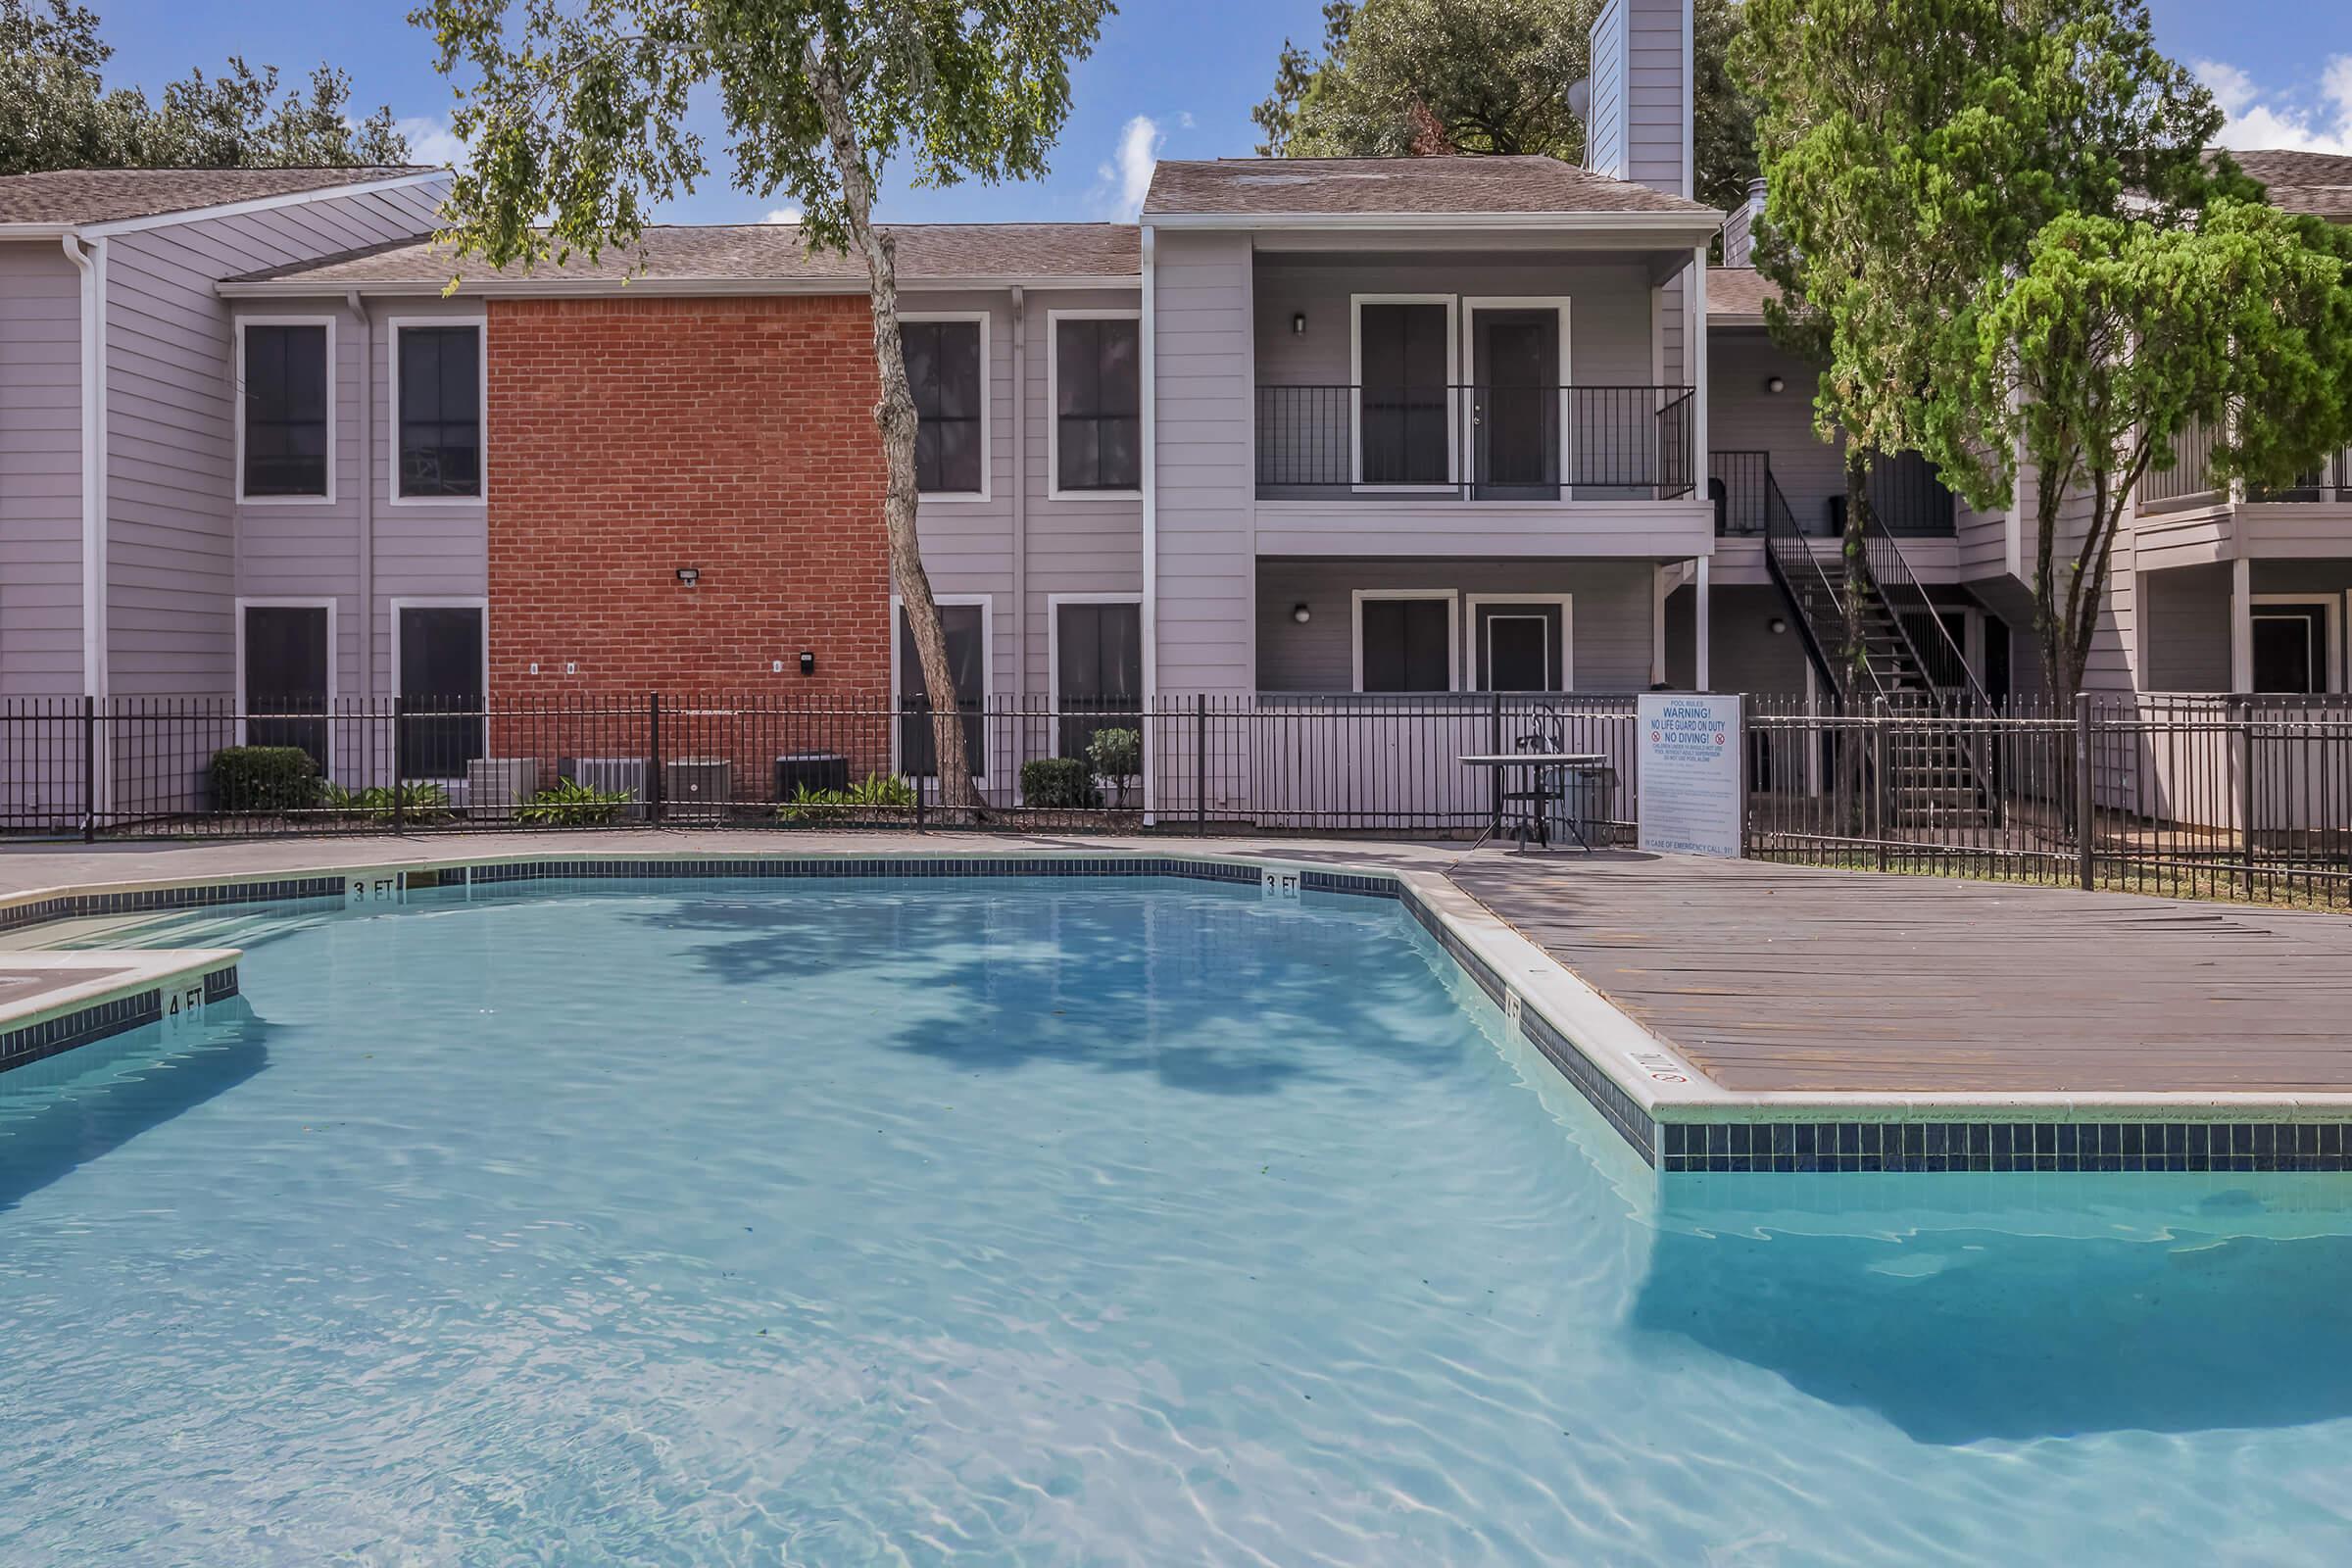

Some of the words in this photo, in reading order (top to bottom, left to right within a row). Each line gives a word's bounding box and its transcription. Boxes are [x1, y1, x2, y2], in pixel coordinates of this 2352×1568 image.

[1663, 708, 1711, 718] WARNING!
[1651, 719, 1660, 730] NO
[1662, 719, 1674, 730] LIFE
[1675, 719, 1696, 731] GUARD
[1697, 721, 1707, 731] ON
[1708, 720, 1726, 732] DUTY
[1665, 732, 1677, 743] NO
[1679, 732, 1709, 745] DIVING!
[1651, 839, 1665, 848] CASE
[354, 881, 365, 894] 3
[374, 879, 394, 894] FT
[1266, 875, 1275, 887] 3
[1283, 876, 1298, 890] FT
[170, 995, 179, 1015] 4
[186, 987, 202, 1011] FT
